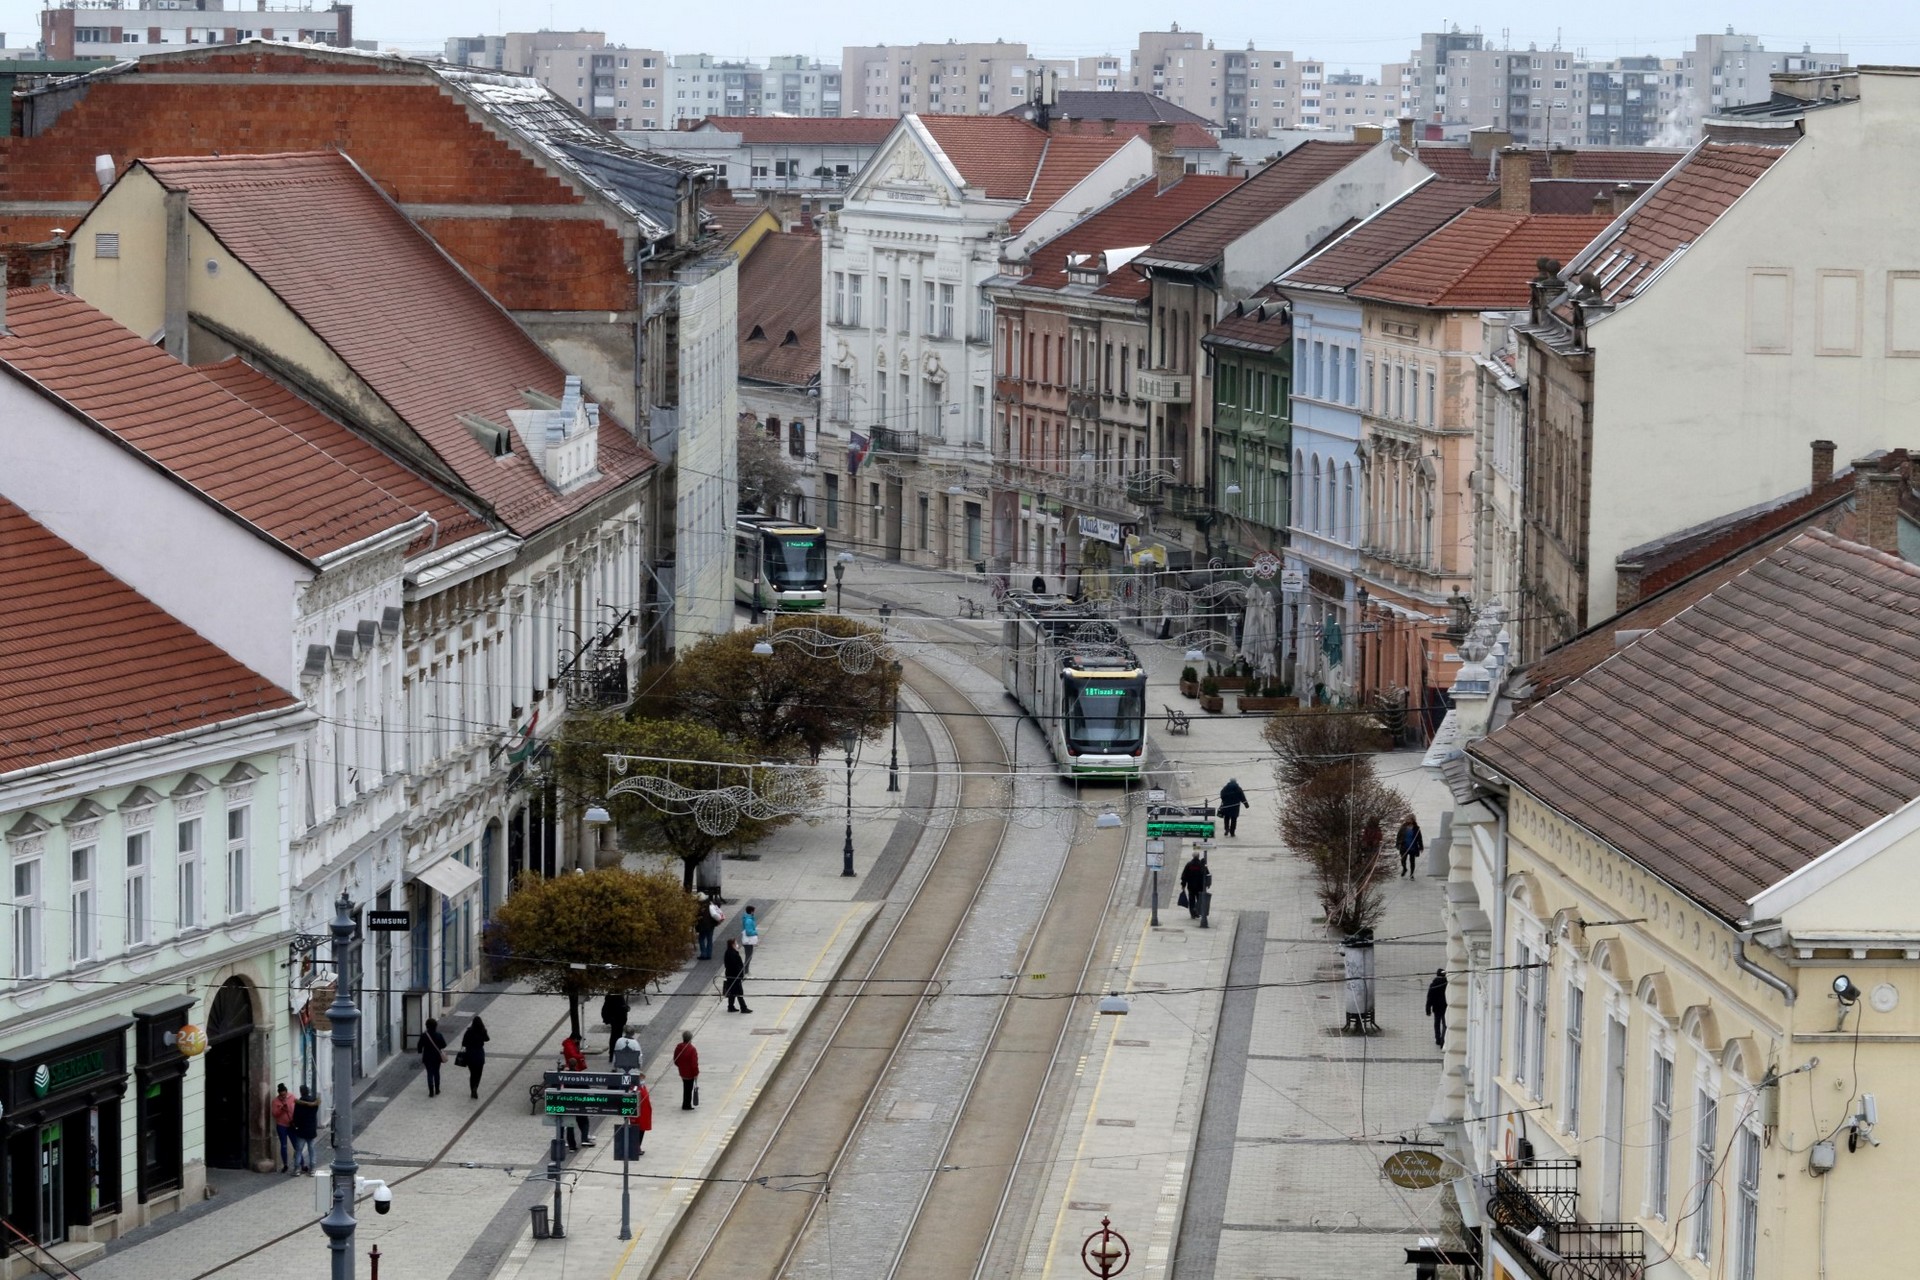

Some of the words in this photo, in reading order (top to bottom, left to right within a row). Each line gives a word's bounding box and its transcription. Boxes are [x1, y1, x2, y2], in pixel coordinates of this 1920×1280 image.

[371, 917, 408, 925] SAMSUNG
[178, 1030, 197, 1044] 24
[558, 1075, 594, 1083] Városház
